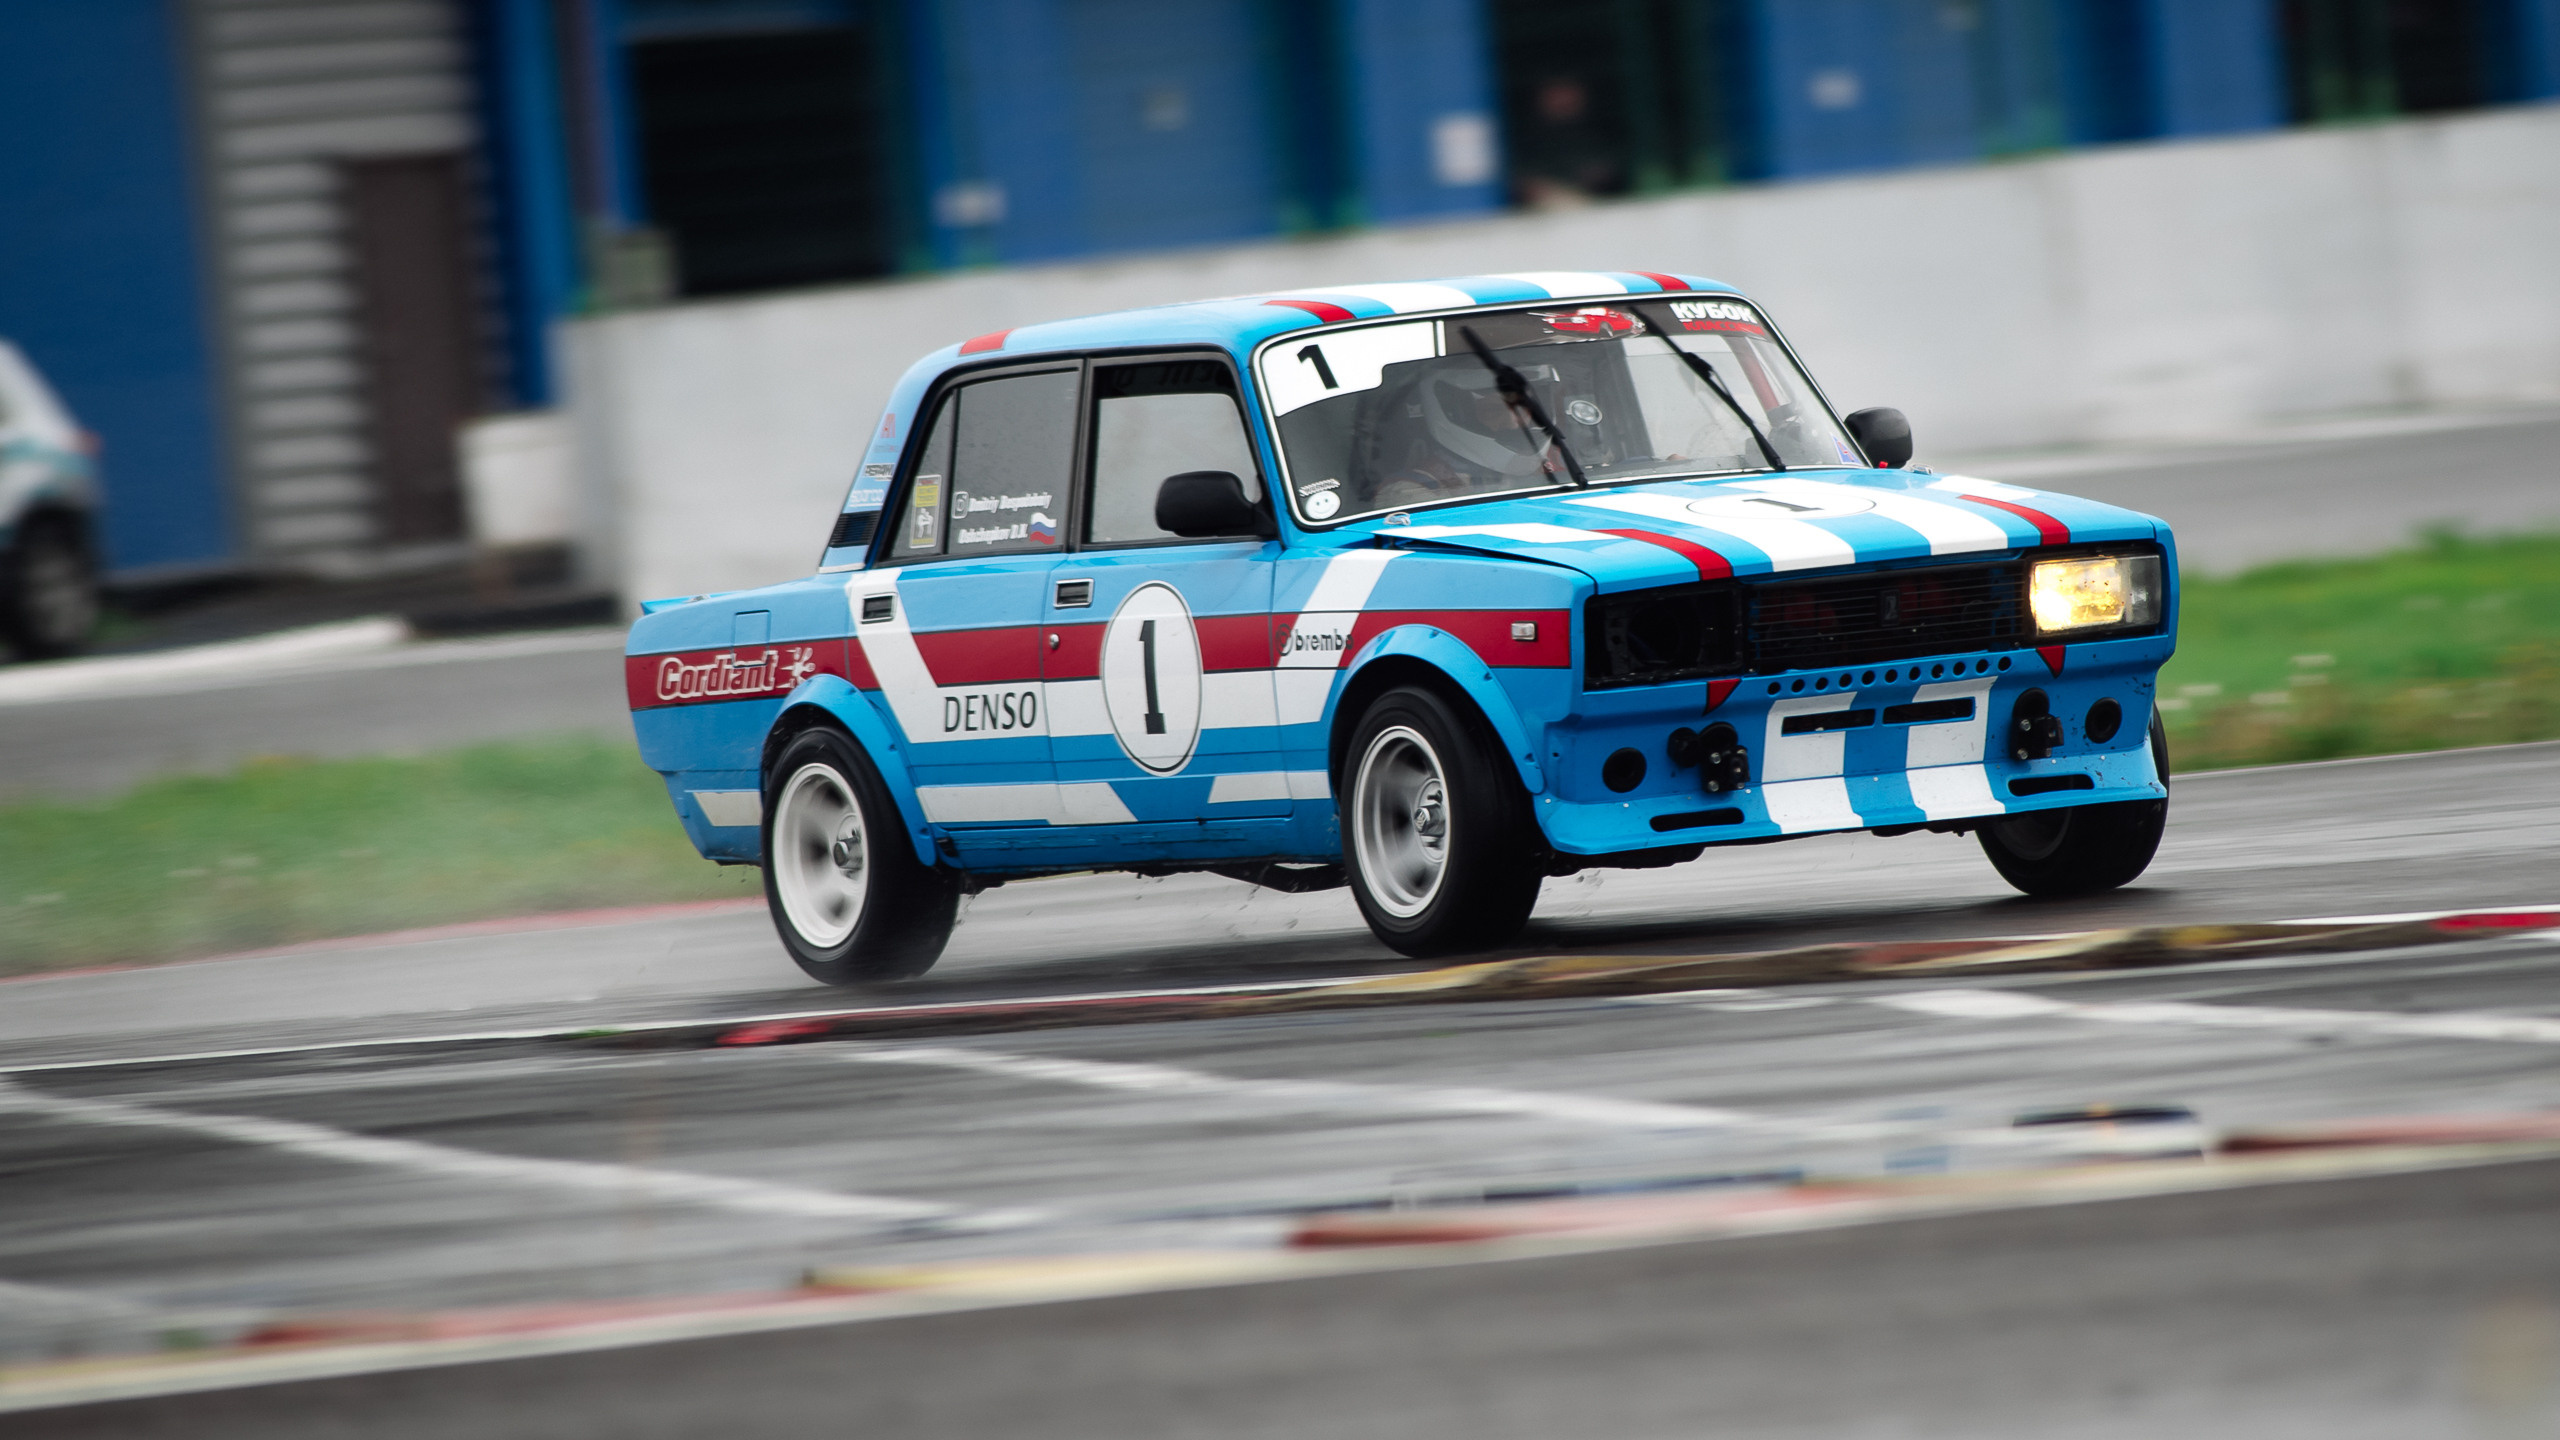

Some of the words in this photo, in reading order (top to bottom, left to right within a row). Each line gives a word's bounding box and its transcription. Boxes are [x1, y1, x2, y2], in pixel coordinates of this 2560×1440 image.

[1669, 302, 1758, 324] КУБОК
[1297, 344, 1339, 389] 1
[1742, 498, 1824, 512] 1
[1295, 628, 1354, 651] brembo
[657, 649, 779, 700] Cordiant
[1139, 619, 1167, 735] 1
[944, 691, 1037, 732] DENSO
